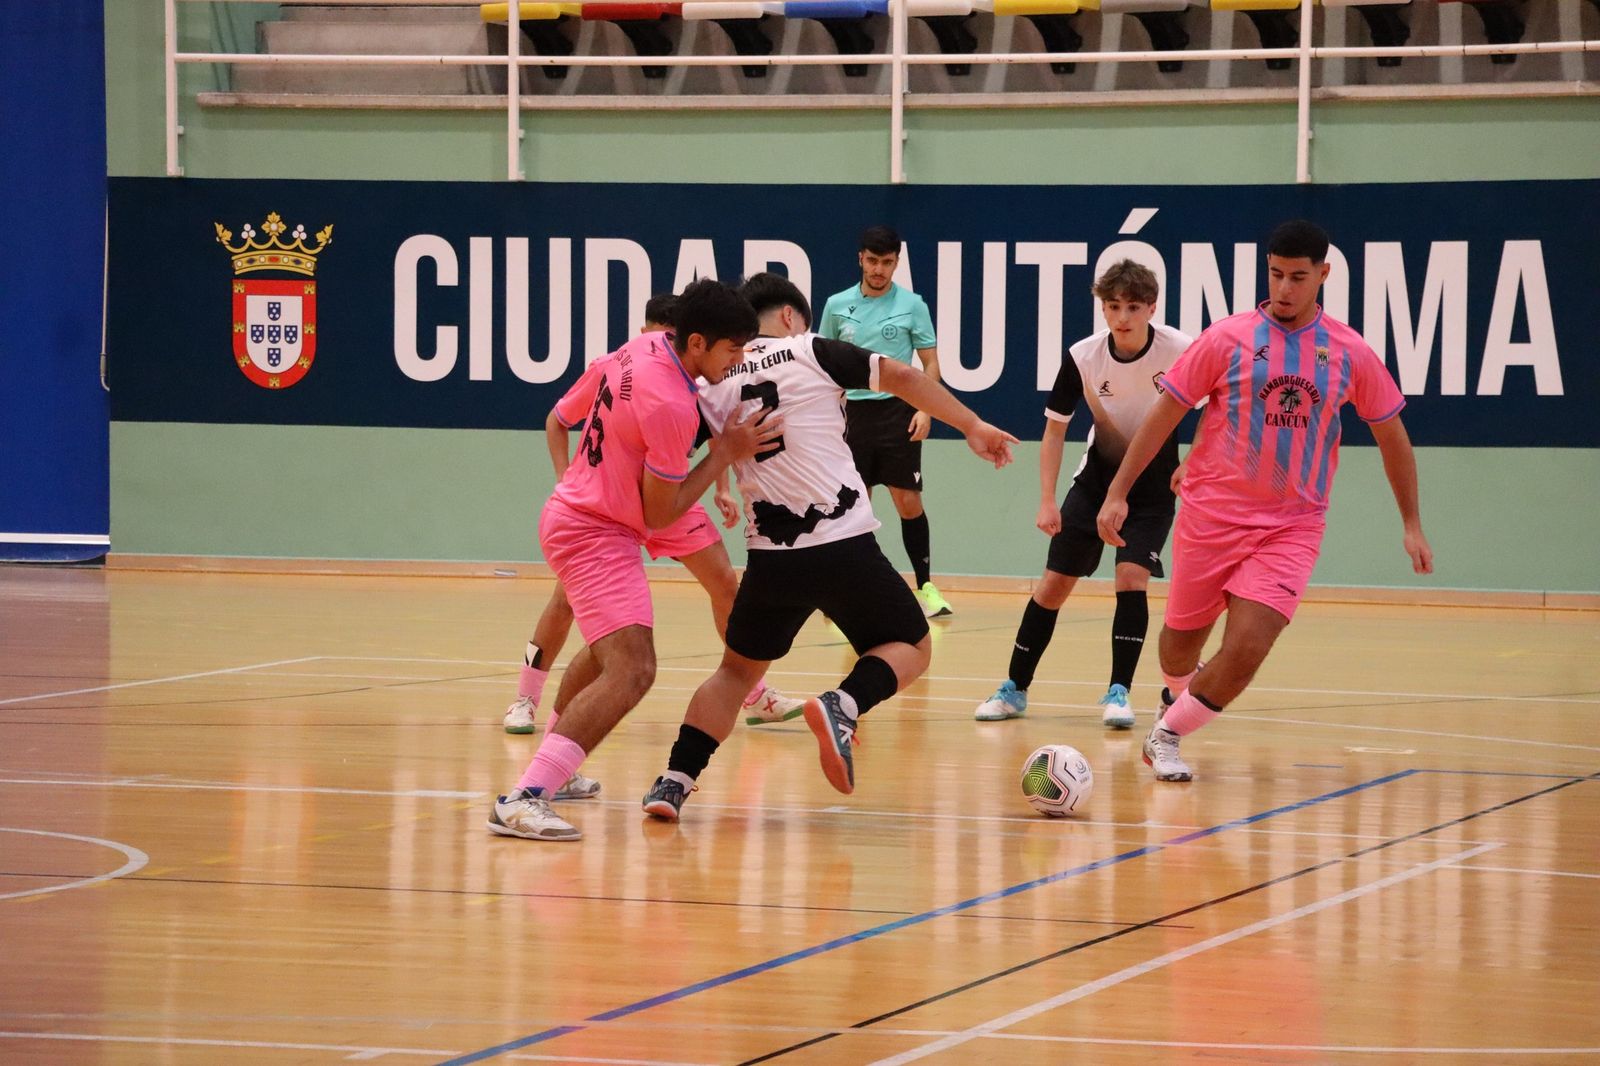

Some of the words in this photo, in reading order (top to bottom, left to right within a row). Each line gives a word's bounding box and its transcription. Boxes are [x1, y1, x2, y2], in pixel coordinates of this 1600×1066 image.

[761, 348, 796, 370] CEUTA
[1258, 374, 1321, 405] HAMBURGUESERIA
[1264, 411, 1310, 429] CANCÚN
